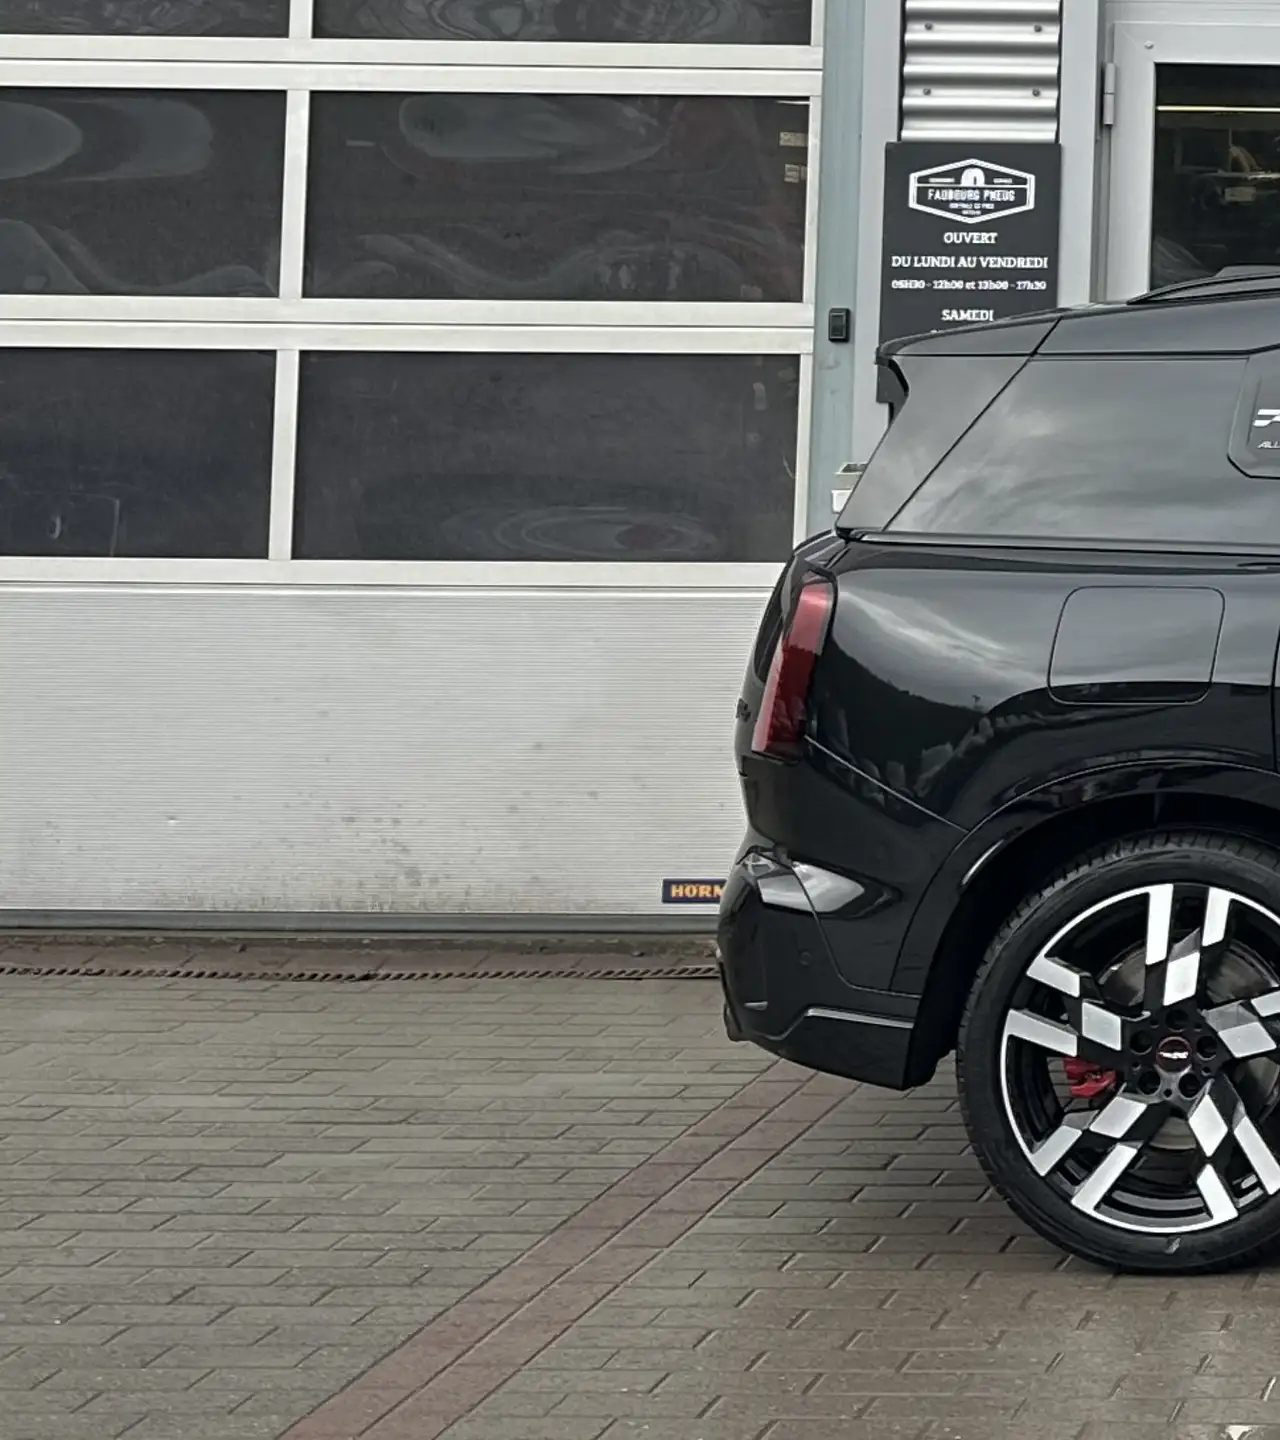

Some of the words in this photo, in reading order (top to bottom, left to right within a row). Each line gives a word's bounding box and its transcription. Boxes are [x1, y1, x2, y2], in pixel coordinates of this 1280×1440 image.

[944, 232, 998, 243] OUVERT
[892, 256, 911, 267] DU
[914, 256, 955, 267] LUNDI
[957, 256, 977, 268] AU
[979, 256, 1048, 268] VENDREDI
[942, 310, 993, 321] SAMEDI
